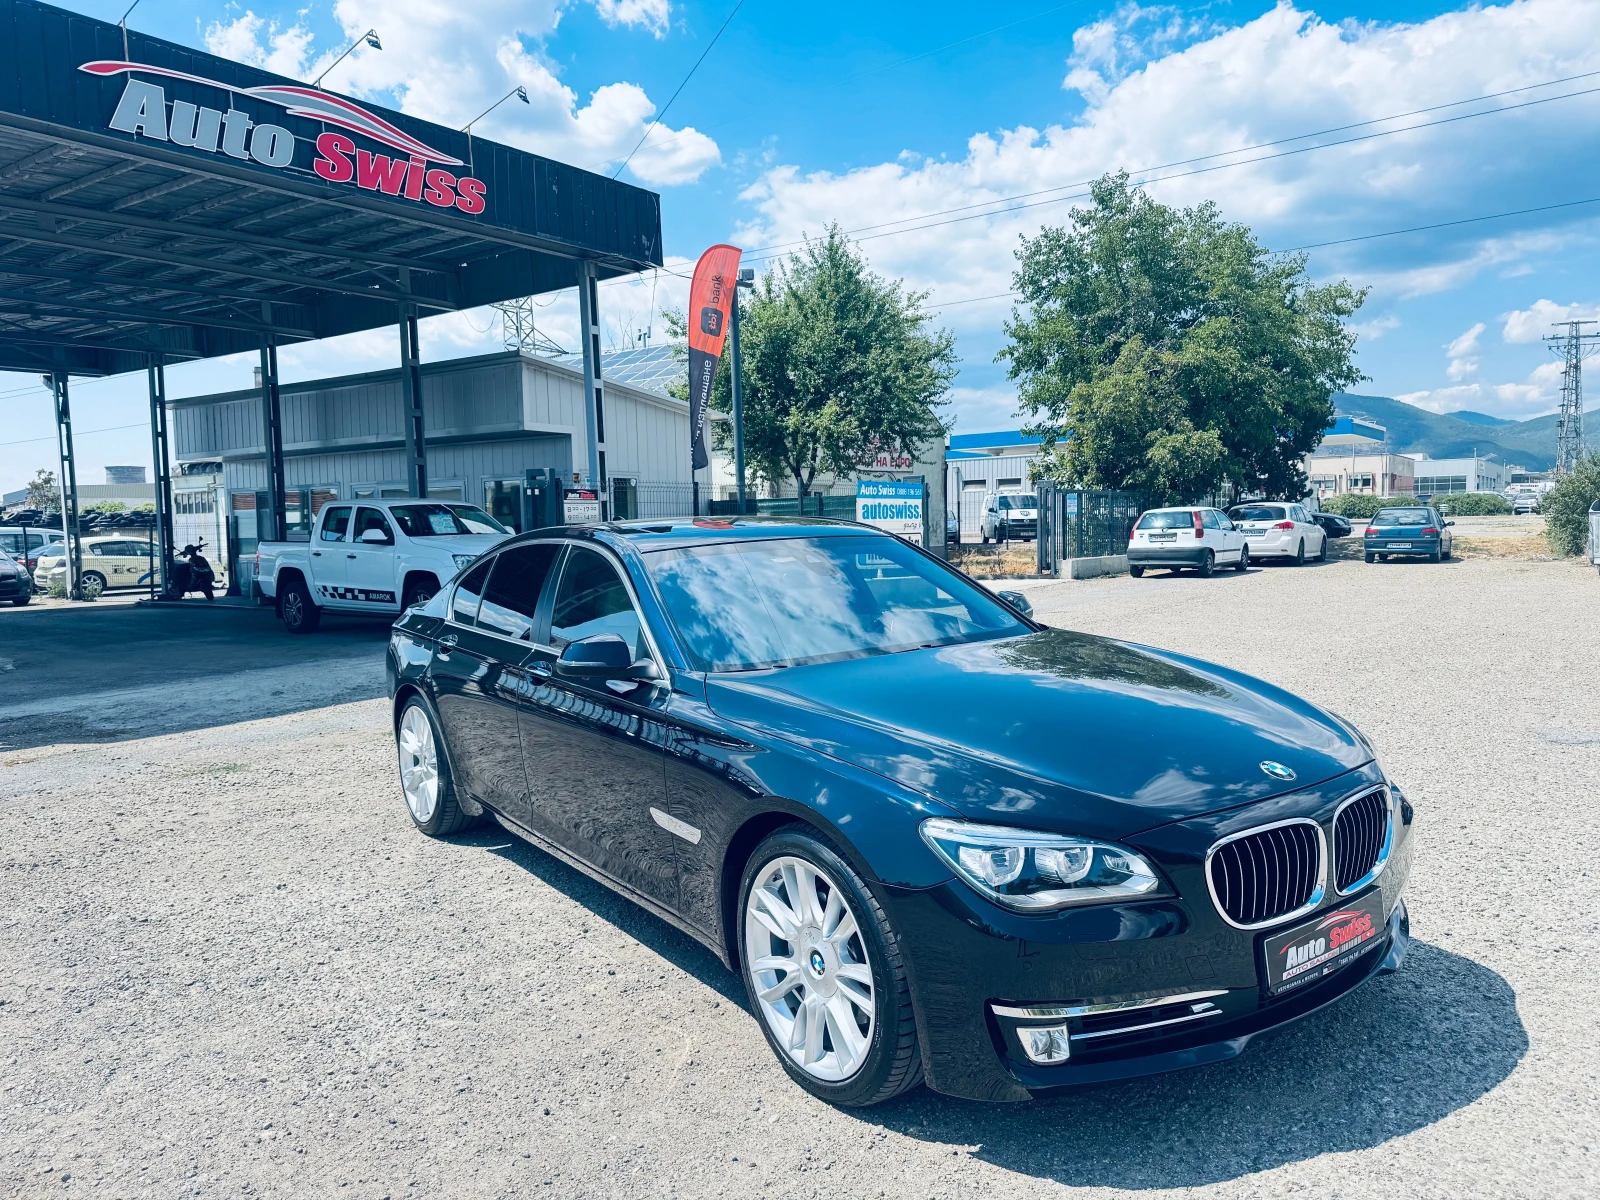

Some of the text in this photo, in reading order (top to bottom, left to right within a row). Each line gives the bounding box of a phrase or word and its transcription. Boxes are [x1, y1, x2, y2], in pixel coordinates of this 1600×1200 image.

[108, 78, 487, 214] Auto Swiss
[708, 275, 722, 330] tbi bank
[876, 456, 888, 467] НА
[860, 484, 877, 495] Auto
[878, 484, 896, 496] Swiss
[369, 592, 391, 601] AMAROK
[1285, 937, 1326, 971] Auto
[1329, 913, 1372, 950] Swiss
[1285, 964, 1309, 979] AUTO
